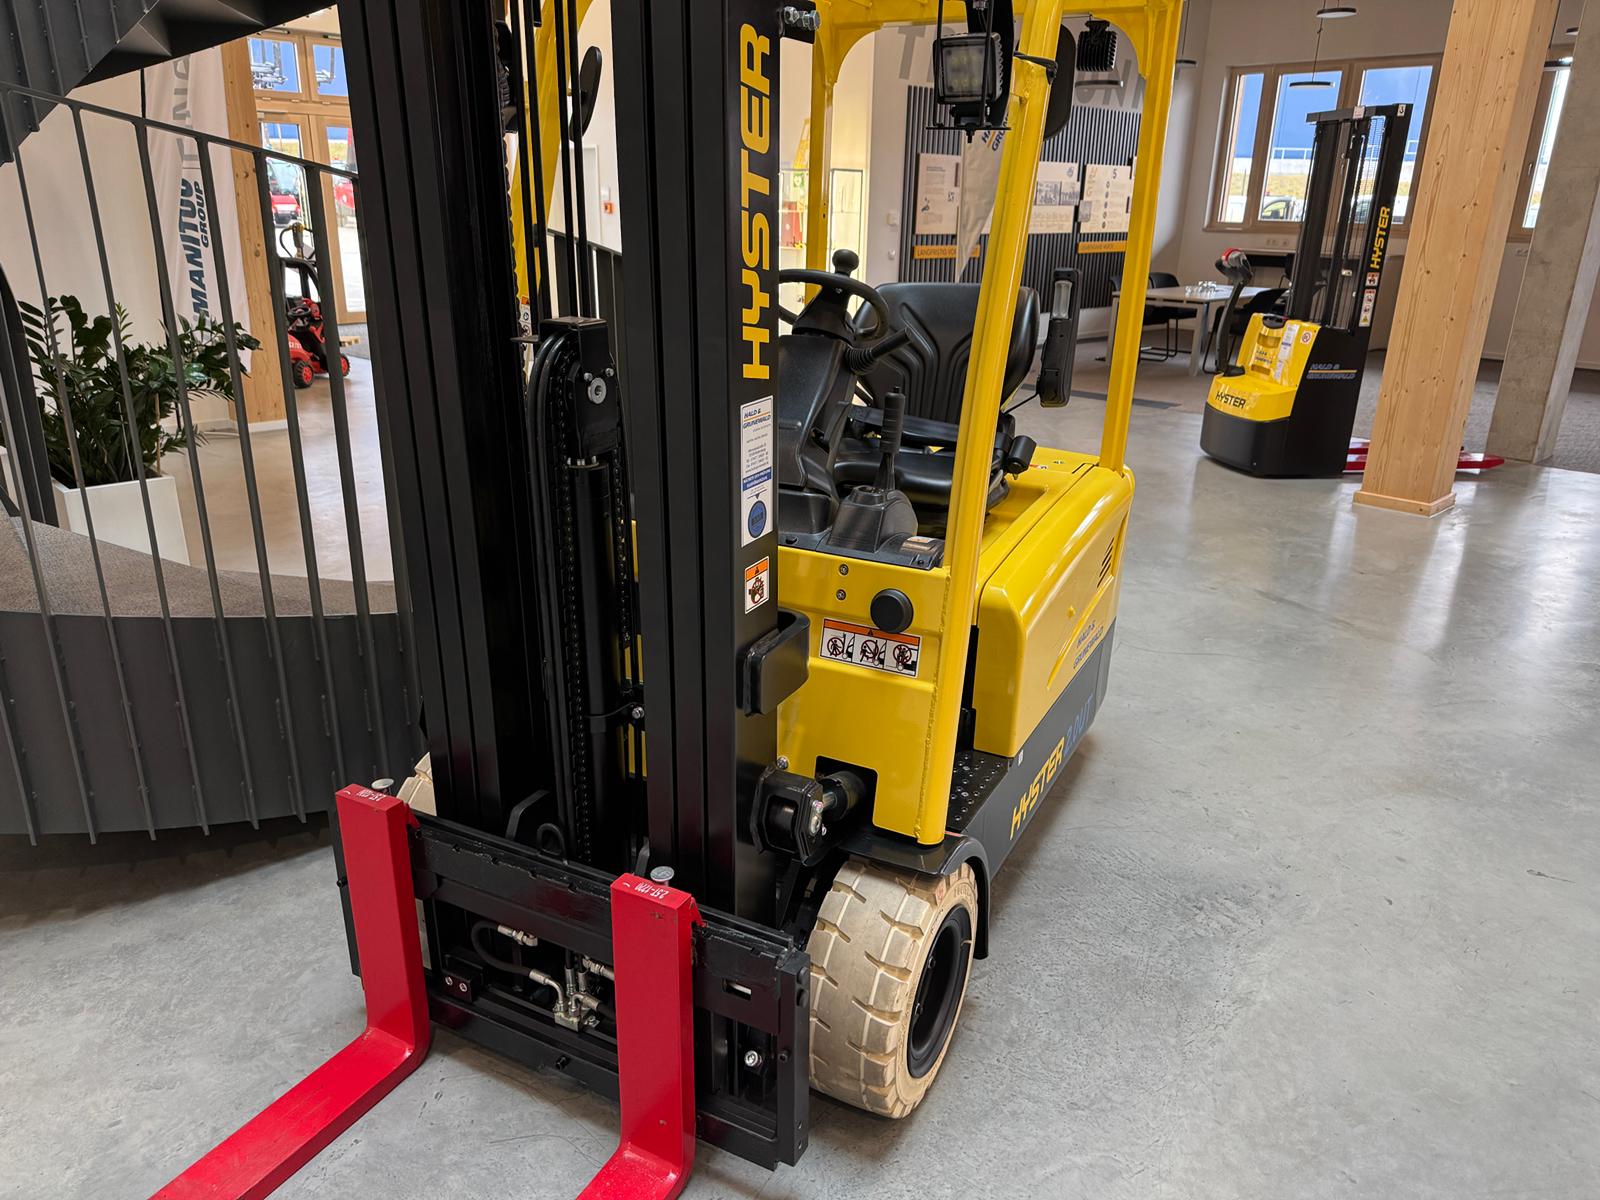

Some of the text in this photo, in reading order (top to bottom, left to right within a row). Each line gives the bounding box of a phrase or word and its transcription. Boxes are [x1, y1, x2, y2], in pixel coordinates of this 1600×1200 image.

[194, 180, 209, 248] GROUP
[740, 23, 770, 380] HYSTER
[1370, 206, 1391, 269] HYSTER
[1215, 390, 1247, 409] HYSTER
[1010, 736, 1065, 840] HYSTER
